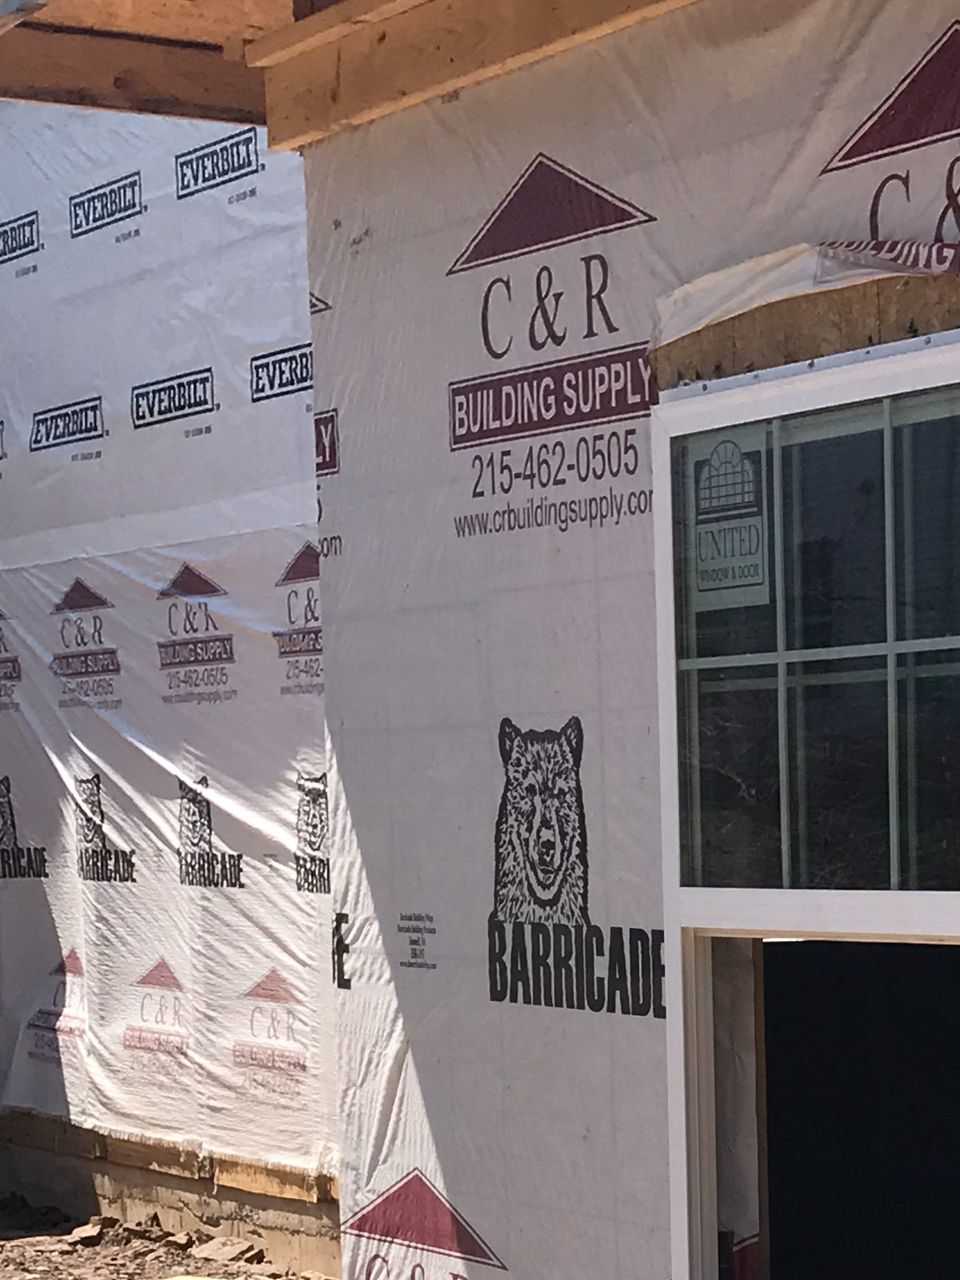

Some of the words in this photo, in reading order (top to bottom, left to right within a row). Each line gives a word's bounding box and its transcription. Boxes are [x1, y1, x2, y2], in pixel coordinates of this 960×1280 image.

[179, 136, 253, 191] EVERBILT
[73, 180, 137, 230] EVERBILT
[481, 277, 513, 359] C
[528, 265, 567, 351] &
[580, 254, 619, 339] R
[33, 404, 98, 445] EVERBILT
[135, 376, 209, 421] EVERBILT
[454, 379, 555, 436] BUILDING
[563, 358, 652, 415] SUPPLY
[472, 429, 638, 498] 215-462-0505
[698, 524, 760, 562] UNITED
[488, 921, 666, 1019] BARRICADE
